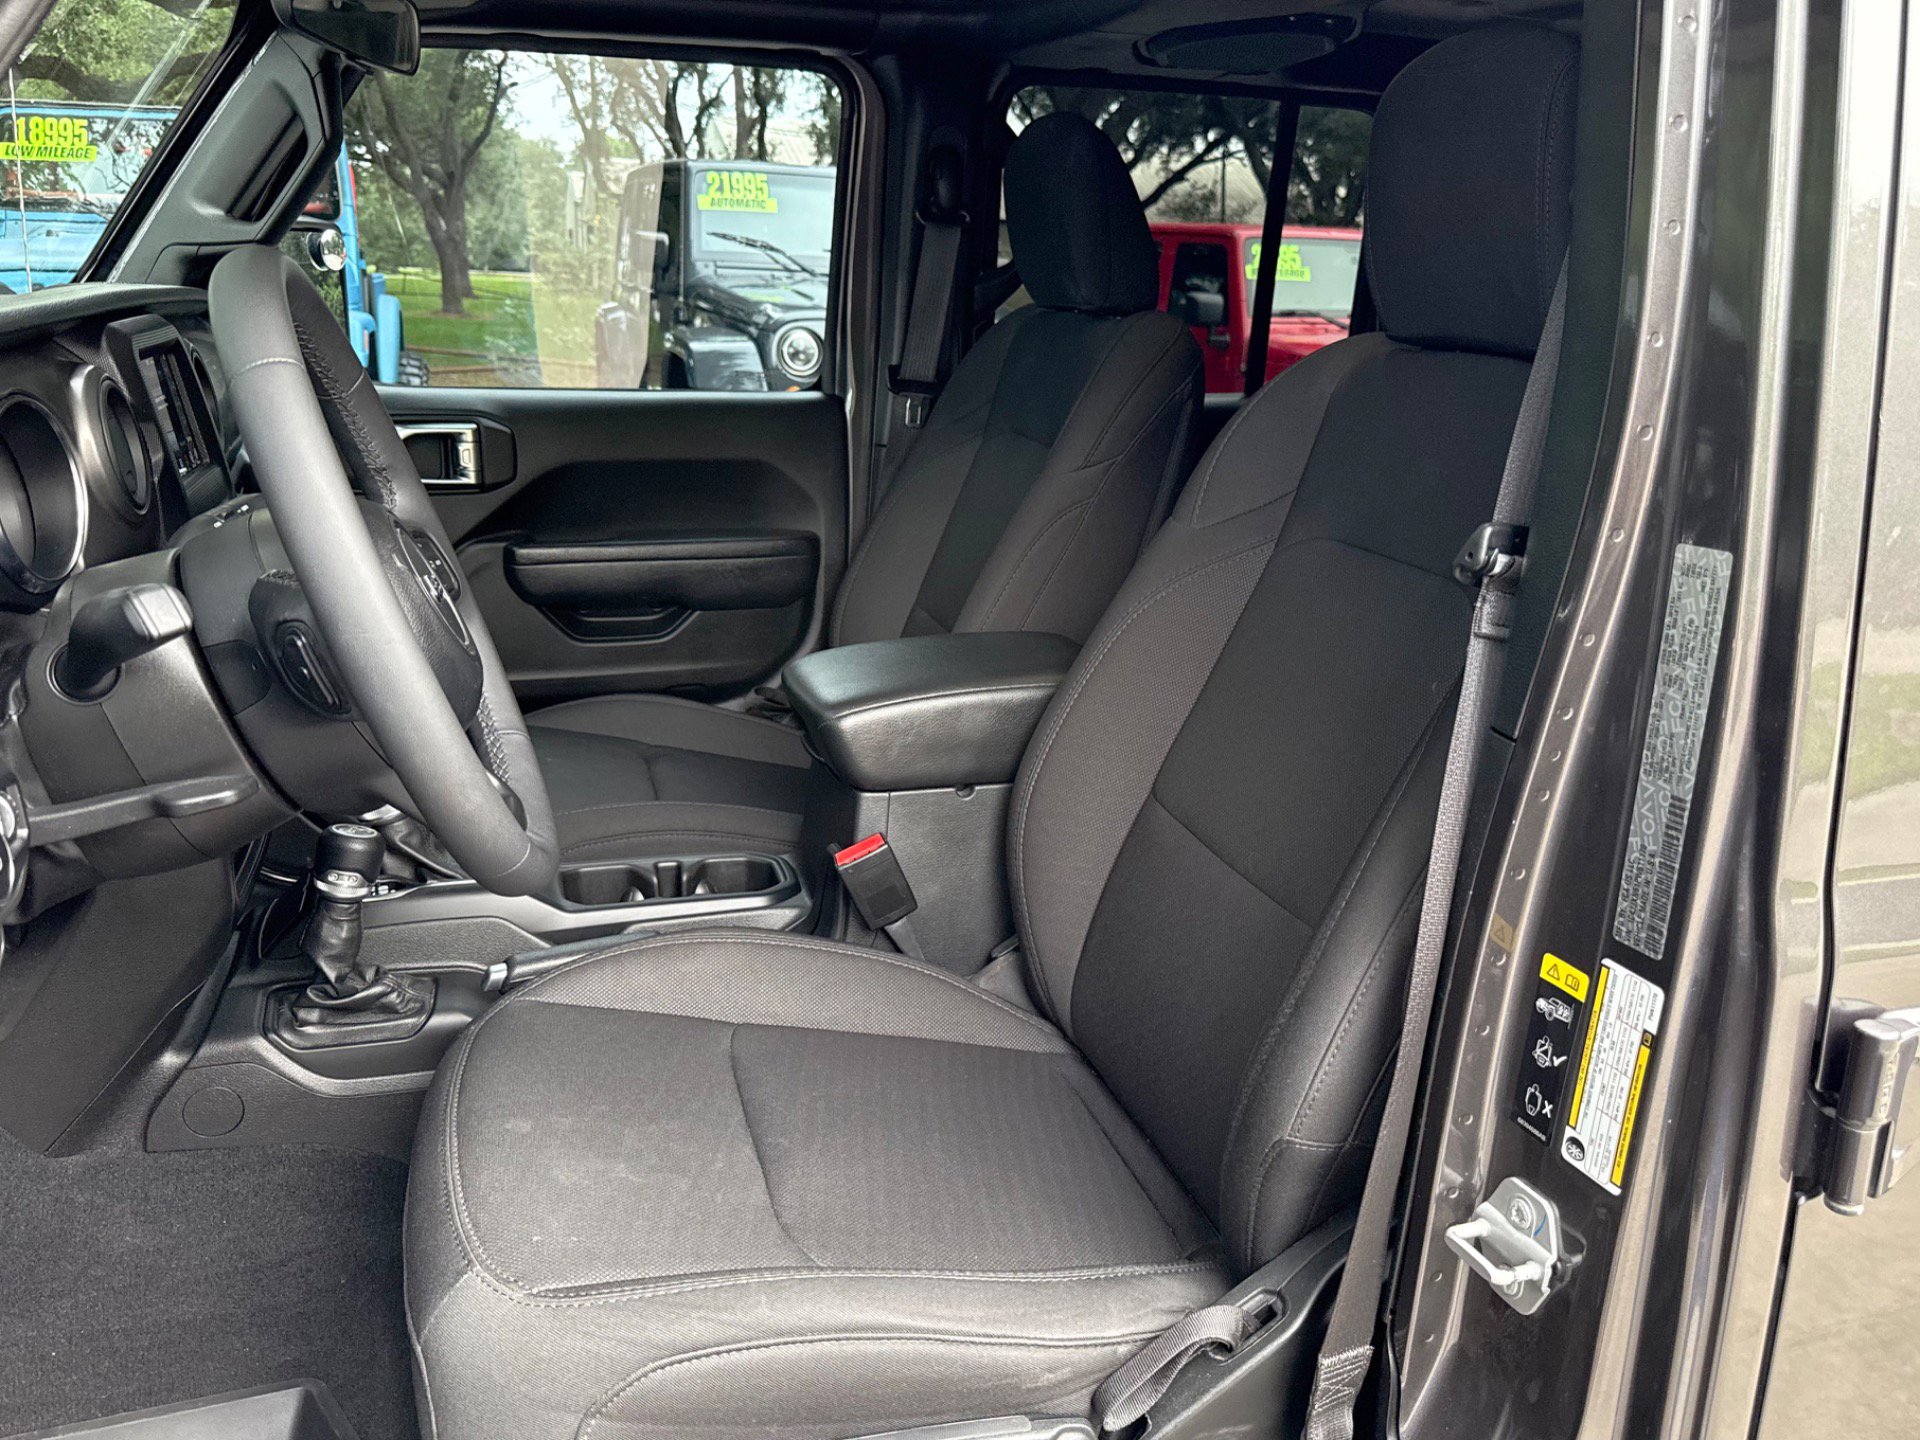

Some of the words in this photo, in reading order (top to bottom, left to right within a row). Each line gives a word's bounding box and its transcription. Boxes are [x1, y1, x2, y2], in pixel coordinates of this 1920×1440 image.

[16, 116, 88, 146] 18995
[5, 145, 34, 157] LOW
[36, 146, 90, 158] MILEAGE
[706, 171, 768, 199] 21995
[710, 198, 766, 209] AUTOMATIC
[1623, 872, 1633, 887] US
